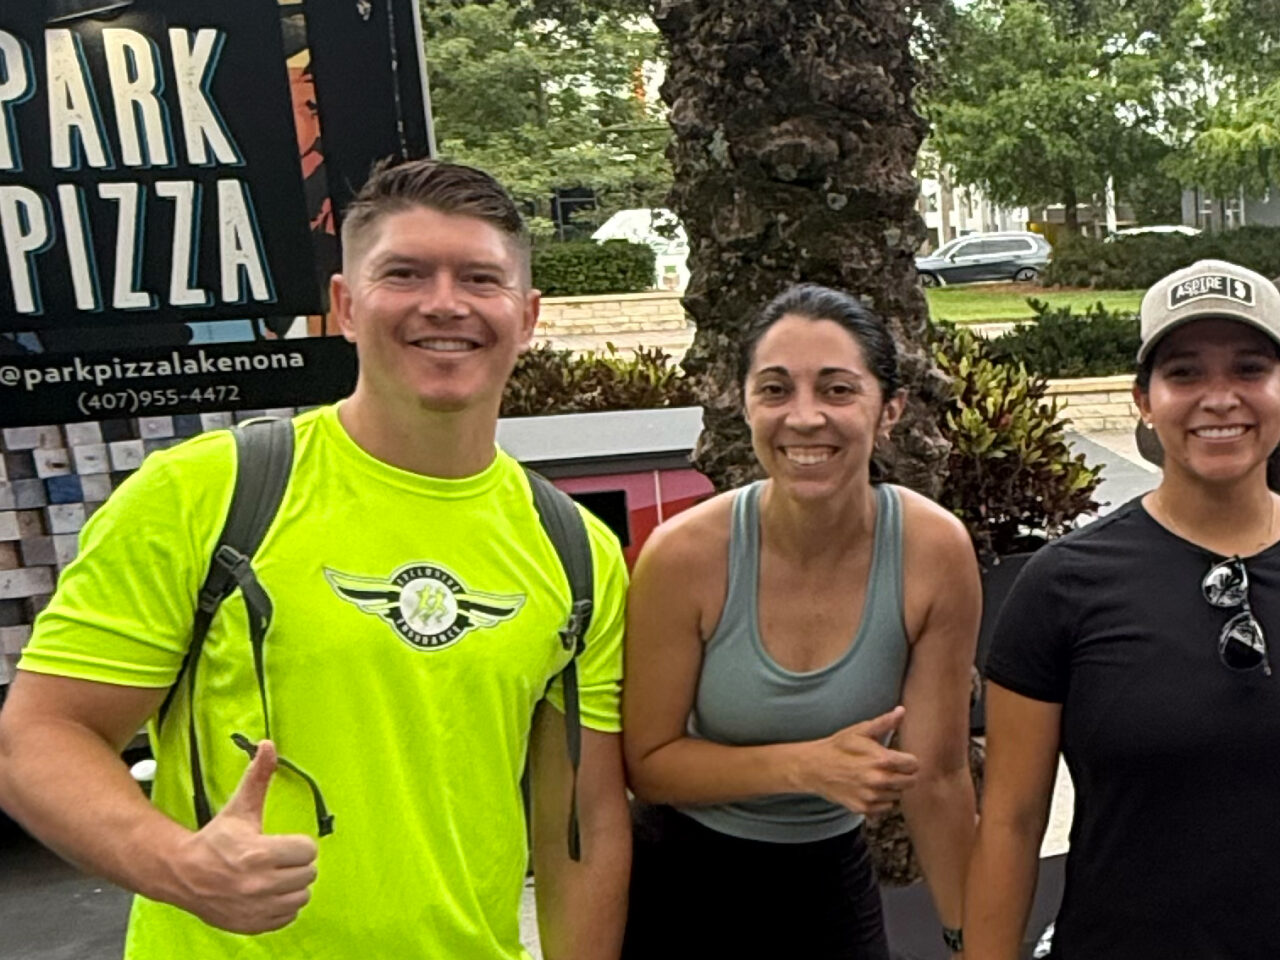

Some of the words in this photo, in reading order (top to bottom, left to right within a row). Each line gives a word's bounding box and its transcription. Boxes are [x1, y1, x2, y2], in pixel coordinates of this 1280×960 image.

[0, 28, 243, 170] PARK
[0, 180, 276, 315] PIZZA
[0, 350, 305, 391] @parkpizzalakenona
[78, 386, 240, 415] (407)955-4472
